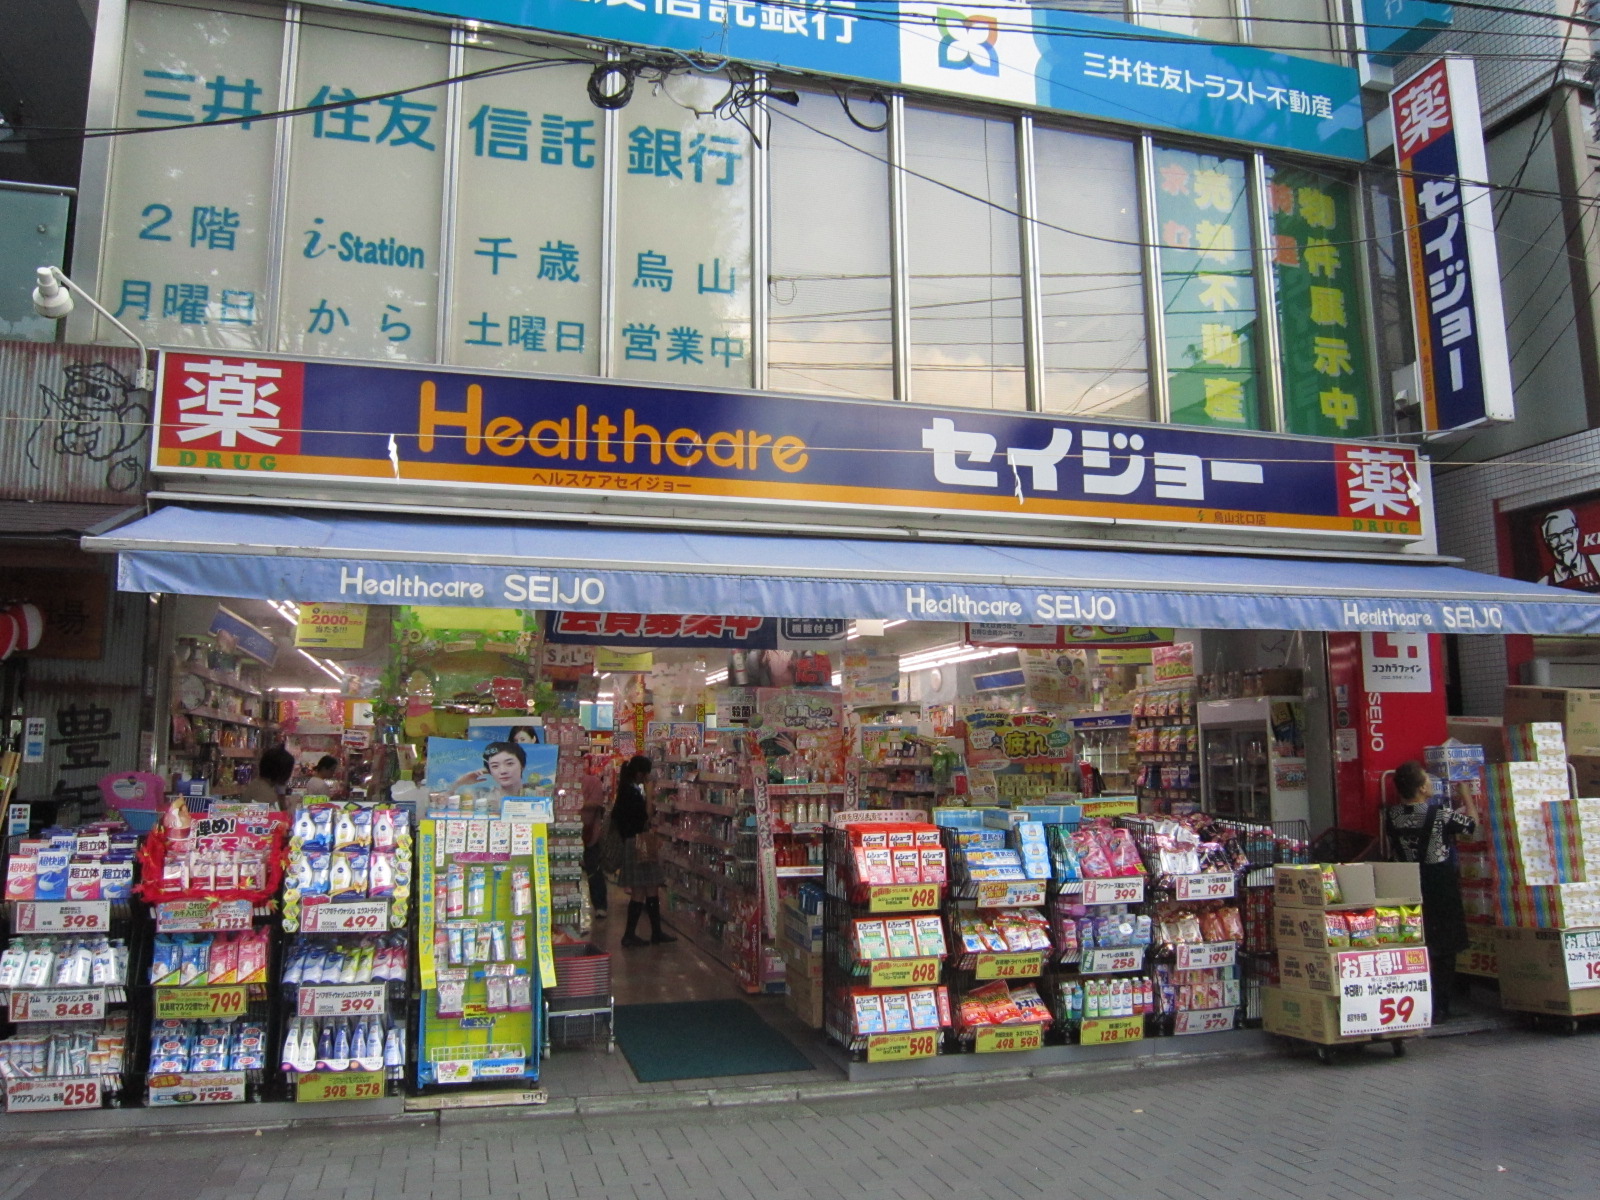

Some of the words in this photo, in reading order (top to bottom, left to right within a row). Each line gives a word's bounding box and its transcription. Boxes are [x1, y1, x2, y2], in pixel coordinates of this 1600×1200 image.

[1083, 51, 1334, 120] 三井住友トラスト不動産
[1398, 69, 1450, 154] 薬
[136, 69, 263, 130] 三井
[307, 84, 438, 151] 住友
[468, 104, 596, 169] 信託
[627, 125, 743, 186] 銀行
[302, 217, 425, 269] i-Station
[473, 237, 580, 283] 千歳
[1417, 174, 1473, 393] セイジョー
[114, 279, 255, 326] 月曜日
[307, 299, 412, 342] から
[464, 312, 586, 355] 土曜日
[622, 322, 745, 369] 営業中
[176, 358, 283, 448] 薬
[417, 380, 809, 474] Healthcare
[178, 450, 278, 471] DRUG
[921, 417, 1264, 501] セイジョー
[532, 472, 692, 492] ヘルスケアセイジョー
[1346, 448, 1411, 517] 薬
[1352, 519, 1410, 534] DRUG
[1583, 532, 1600, 547] K
[339, 565, 485, 600] Healthcare
[503, 573, 606, 606] SEIJO
[906, 587, 1022, 617] Healthcare
[1036, 594, 1117, 621] SEIJO
[1343, 602, 1432, 627] Healthcare
[1443, 605, 1503, 630] SEIJO
[1371, 663, 1422, 673] ココカラファイン
[1367, 691, 1385, 752] SEIJO
[1004, 731, 1049, 757] 疲れ
[78, 841, 107, 852] 超立体
[9, 862, 37, 873] 超快適
[38, 855, 67, 866] 超快適
[69, 867, 100, 879] 超立体
[102, 868, 132, 879] 超立体
[911, 888, 936, 908] 698
[1014, 893, 1040, 903] 158
[1113, 889, 1137, 900] 399
[1207, 884, 1226, 895] 199
[63, 914, 99, 928] 398
[342, 915, 378, 928] 499
[1111, 958, 1136, 969] 258
[1208, 952, 1228, 965] 199
[1341, 951, 1402, 979] お買得!!
[912, 963, 936, 983] 698
[996, 965, 1015, 977] 348
[1020, 964, 1038, 975] 478
[55, 1002, 94, 1017] 848
[210, 991, 242, 1013] 799
[340, 998, 375, 1011] 399
[1379, 995, 1415, 1026] 59
[1100, 1030, 1118, 1041] 128
[1124, 1027, 1140, 1038] 199
[1204, 1018, 1228, 1030] 379
[909, 1036, 934, 1056] 598
[995, 1038, 1014, 1049] 498
[1020, 1036, 1038, 1047] 598
[63, 1081, 97, 1106] 258
[199, 1091, 234, 1102] 198
[323, 1085, 347, 1098] 398
[355, 1082, 380, 1096] 578
